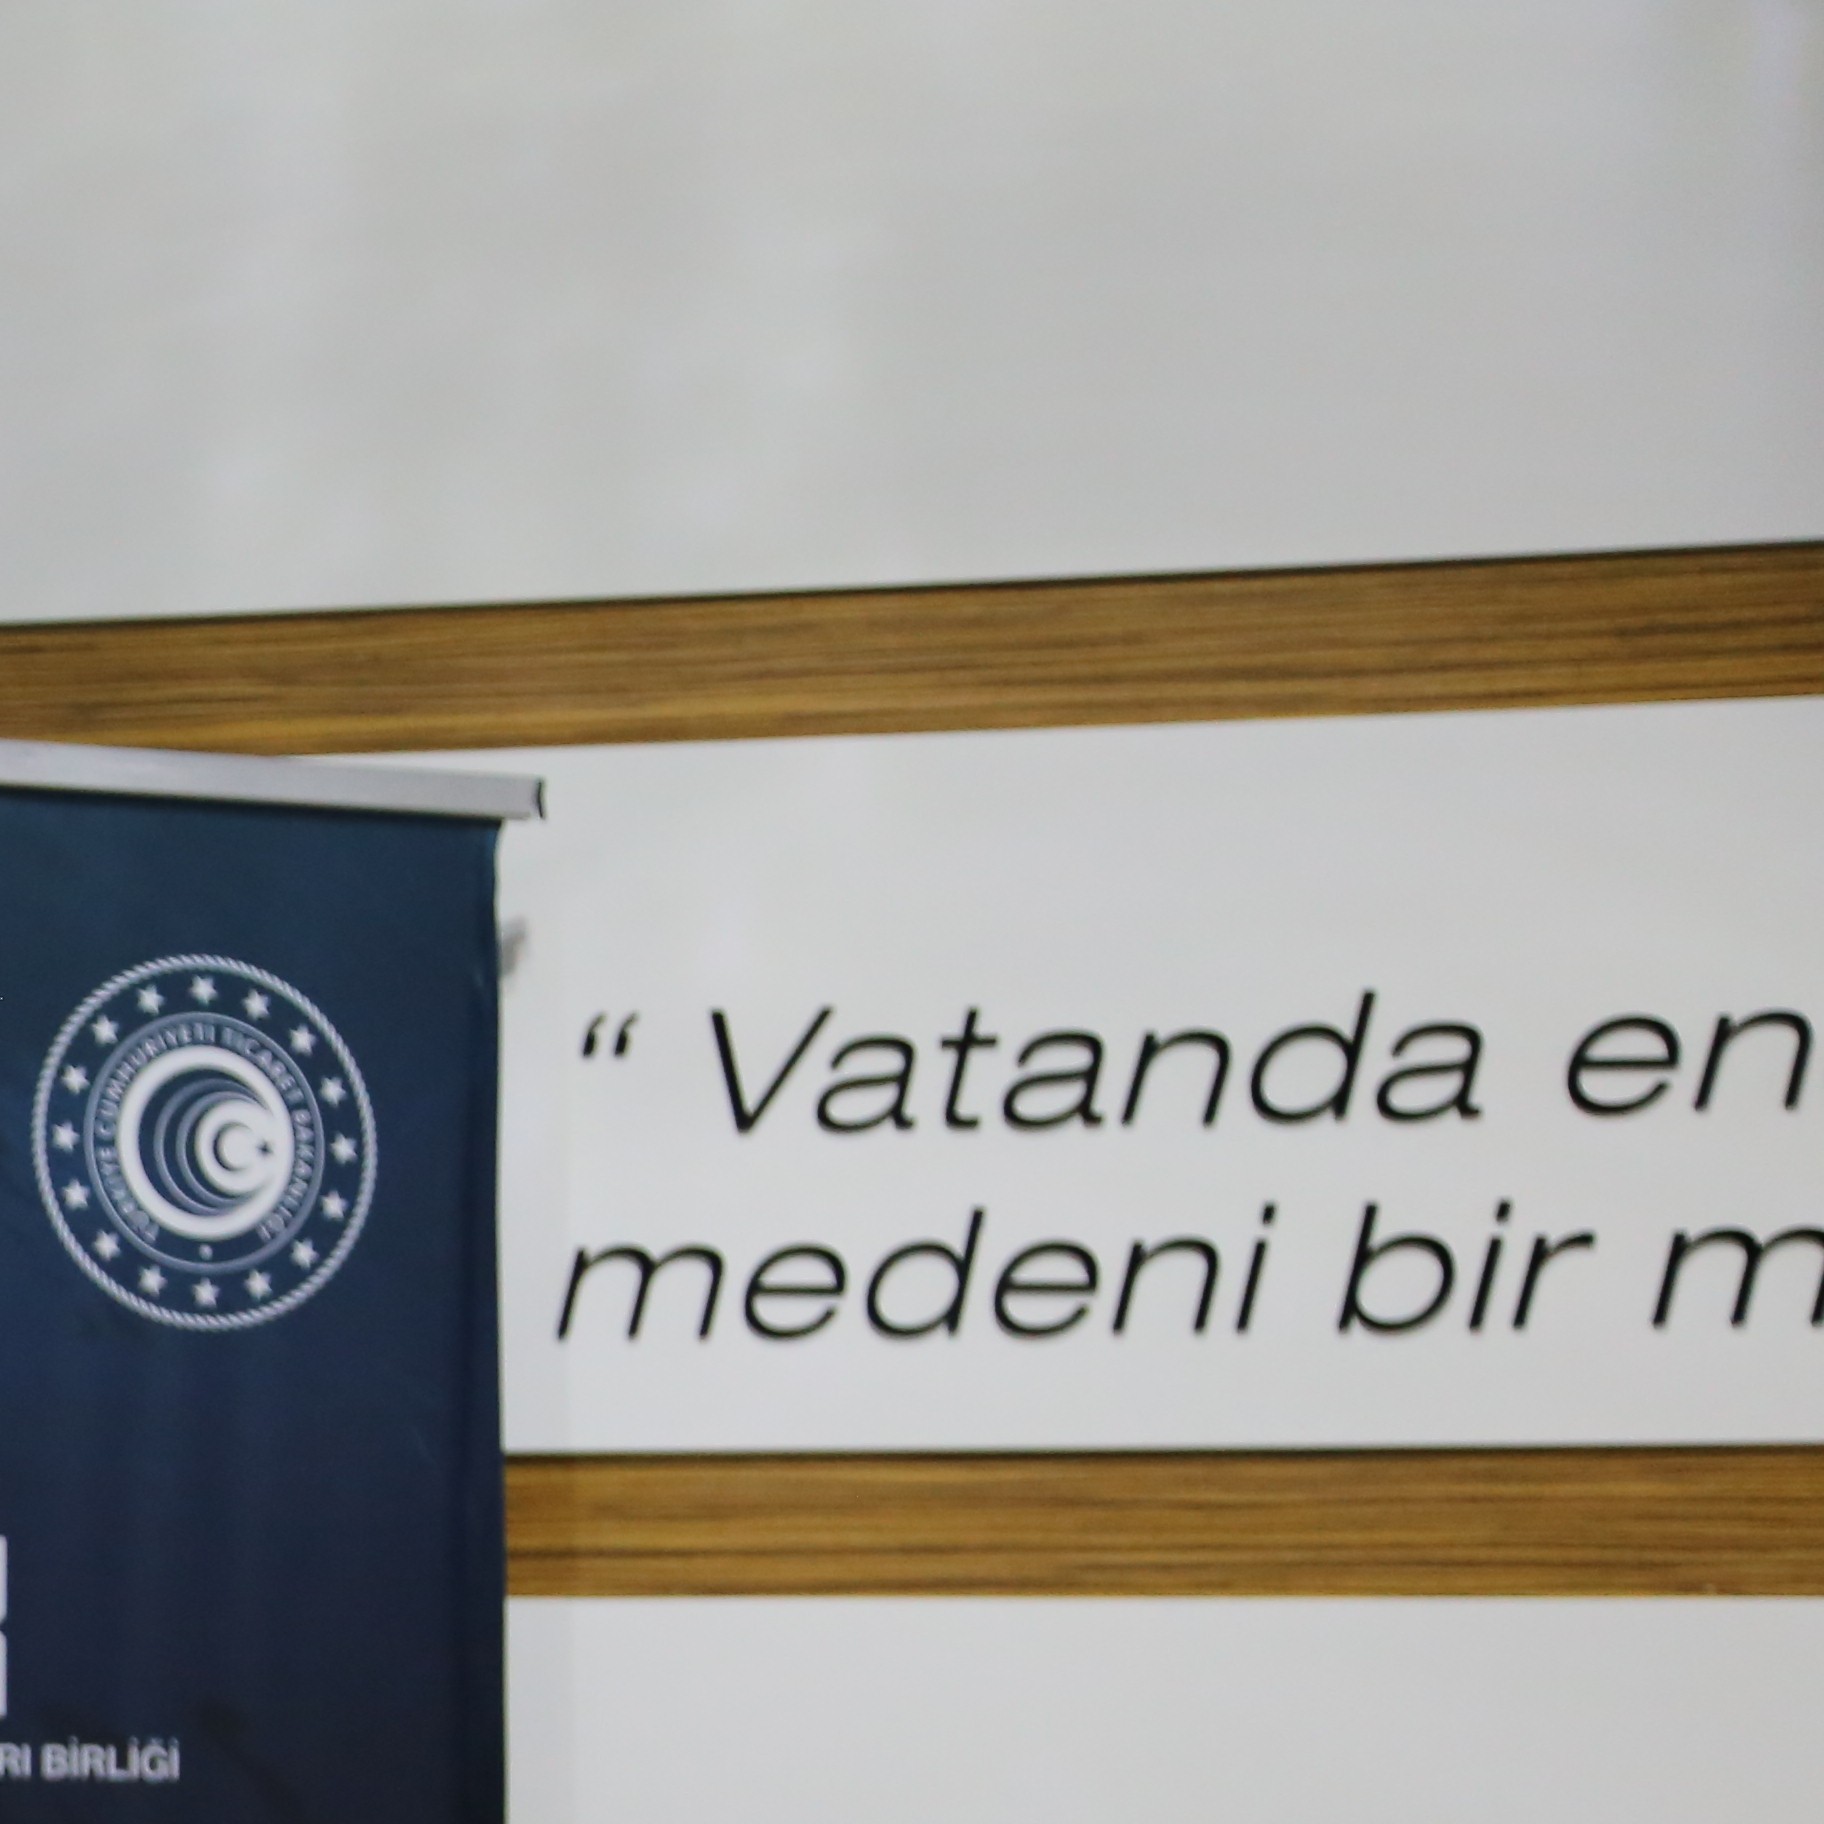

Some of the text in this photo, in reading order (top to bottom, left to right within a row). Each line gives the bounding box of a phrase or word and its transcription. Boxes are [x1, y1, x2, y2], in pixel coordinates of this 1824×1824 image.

[709, 990, 1484, 1136] Vatanda
[1565, 1009, 1814, 1118] en
[555, 1202, 1277, 1342] medeni
[1336, 1200, 1597, 1336] bir
[40, 1735, 181, 1782] BİRLİĞİ
